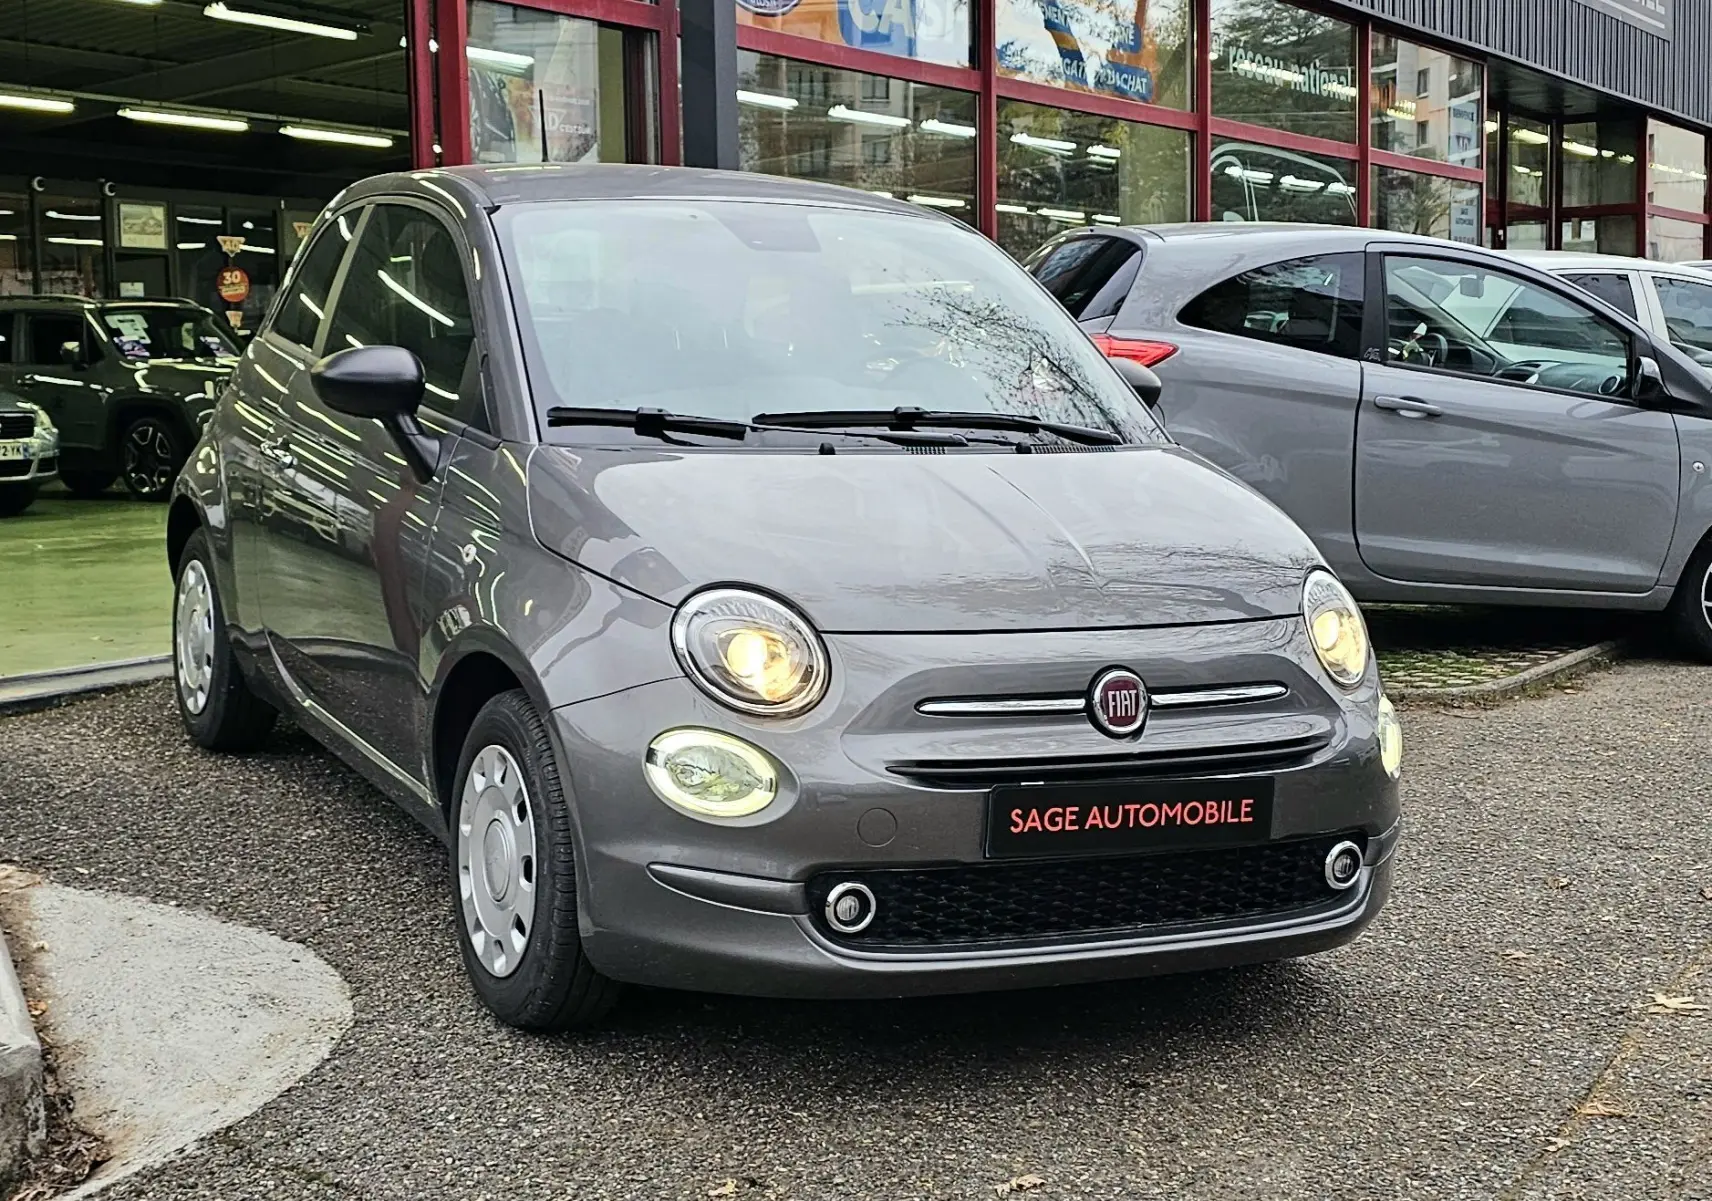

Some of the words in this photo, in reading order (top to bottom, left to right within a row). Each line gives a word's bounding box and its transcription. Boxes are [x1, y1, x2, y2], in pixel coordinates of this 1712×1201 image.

[1290, 58, 1352, 102] national
[223, 270, 241, 285] 30
[0, 445, 22, 457] 2-YK
[1107, 689, 1137, 718] FIAT
[1009, 806, 1080, 833] SAGE
[1084, 799, 1254, 830] AUTOMOBILE
